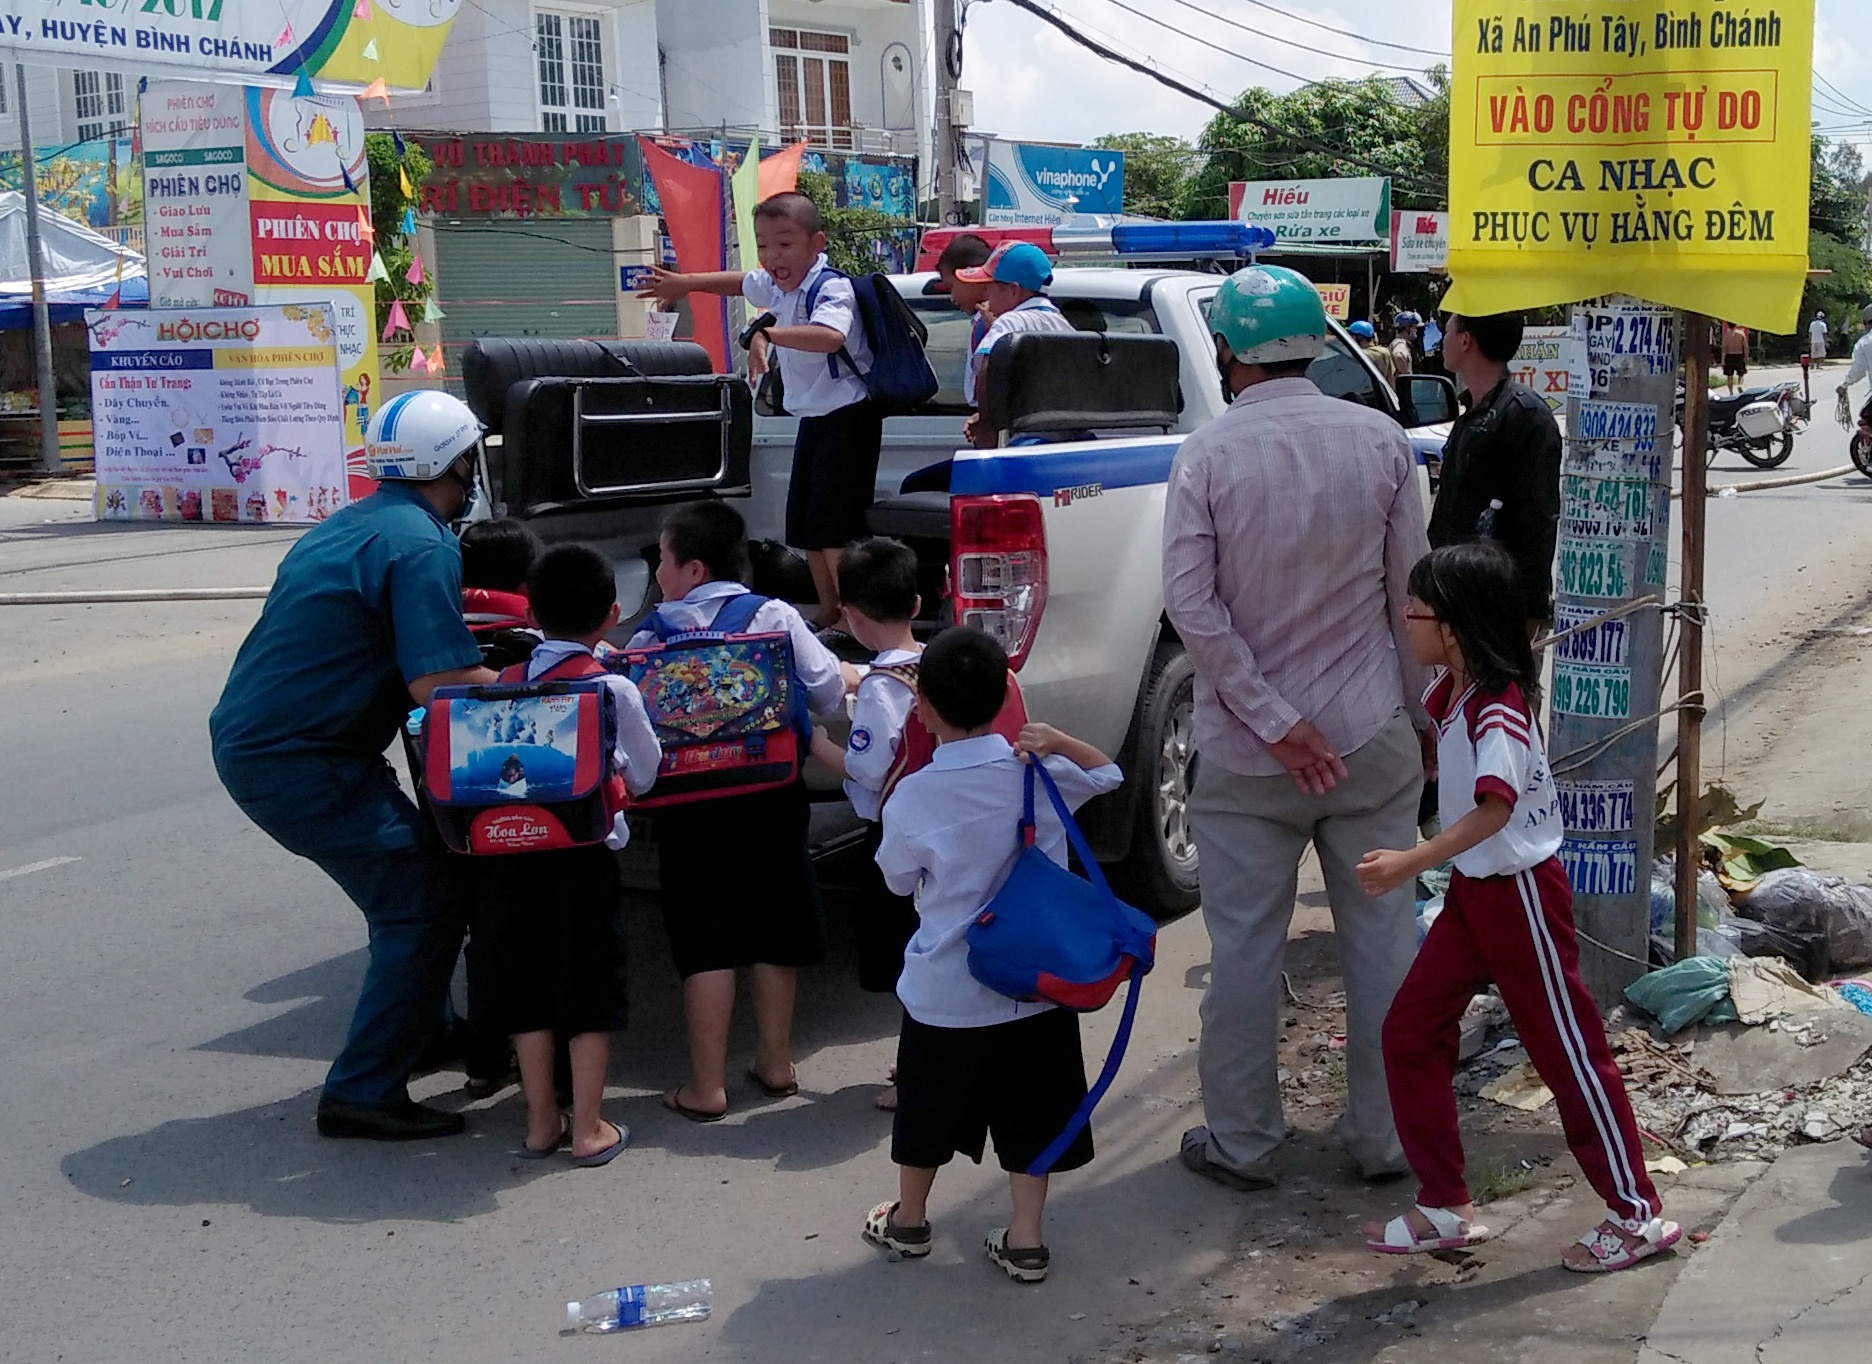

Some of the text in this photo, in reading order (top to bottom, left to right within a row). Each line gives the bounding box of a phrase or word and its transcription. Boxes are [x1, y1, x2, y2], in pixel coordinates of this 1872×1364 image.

[0, 15, 273, 62] Y, HUYỆN BÌNH CHÁNH
[1477, 8, 1781, 58] Xã An Phú Tây, Bình Chánh
[1489, 77, 1761, 140] VÀO CỔNG TỰ DO
[149, 172, 242, 198] PHIÊN CHỢ
[1036, 167, 1097, 188] vinaphone
[1528, 157, 1716, 198] CA NHẠC
[1262, 185, 1309, 205] Hiếu
[159, 205, 211, 217] Giao Lưu
[160, 226, 184, 237] Mua
[257, 214, 361, 247] PHIÊN CHỢ
[1275, 224, 1341, 238] Rửa xe
[1472, 193, 1775, 250] PHỤC VỤ HẰNG ĐÊM
[161, 246, 186, 258] Giải
[260, 244, 364, 278] MUA SẮM
[162, 266, 213, 278] Vui Chơi
[111, 352, 183, 367] KHUYẾN CÁO
[104, 398, 124, 410] Dây
[106, 447, 163, 458] Điện Thoại
[433, 434, 456, 452] Galaxy
